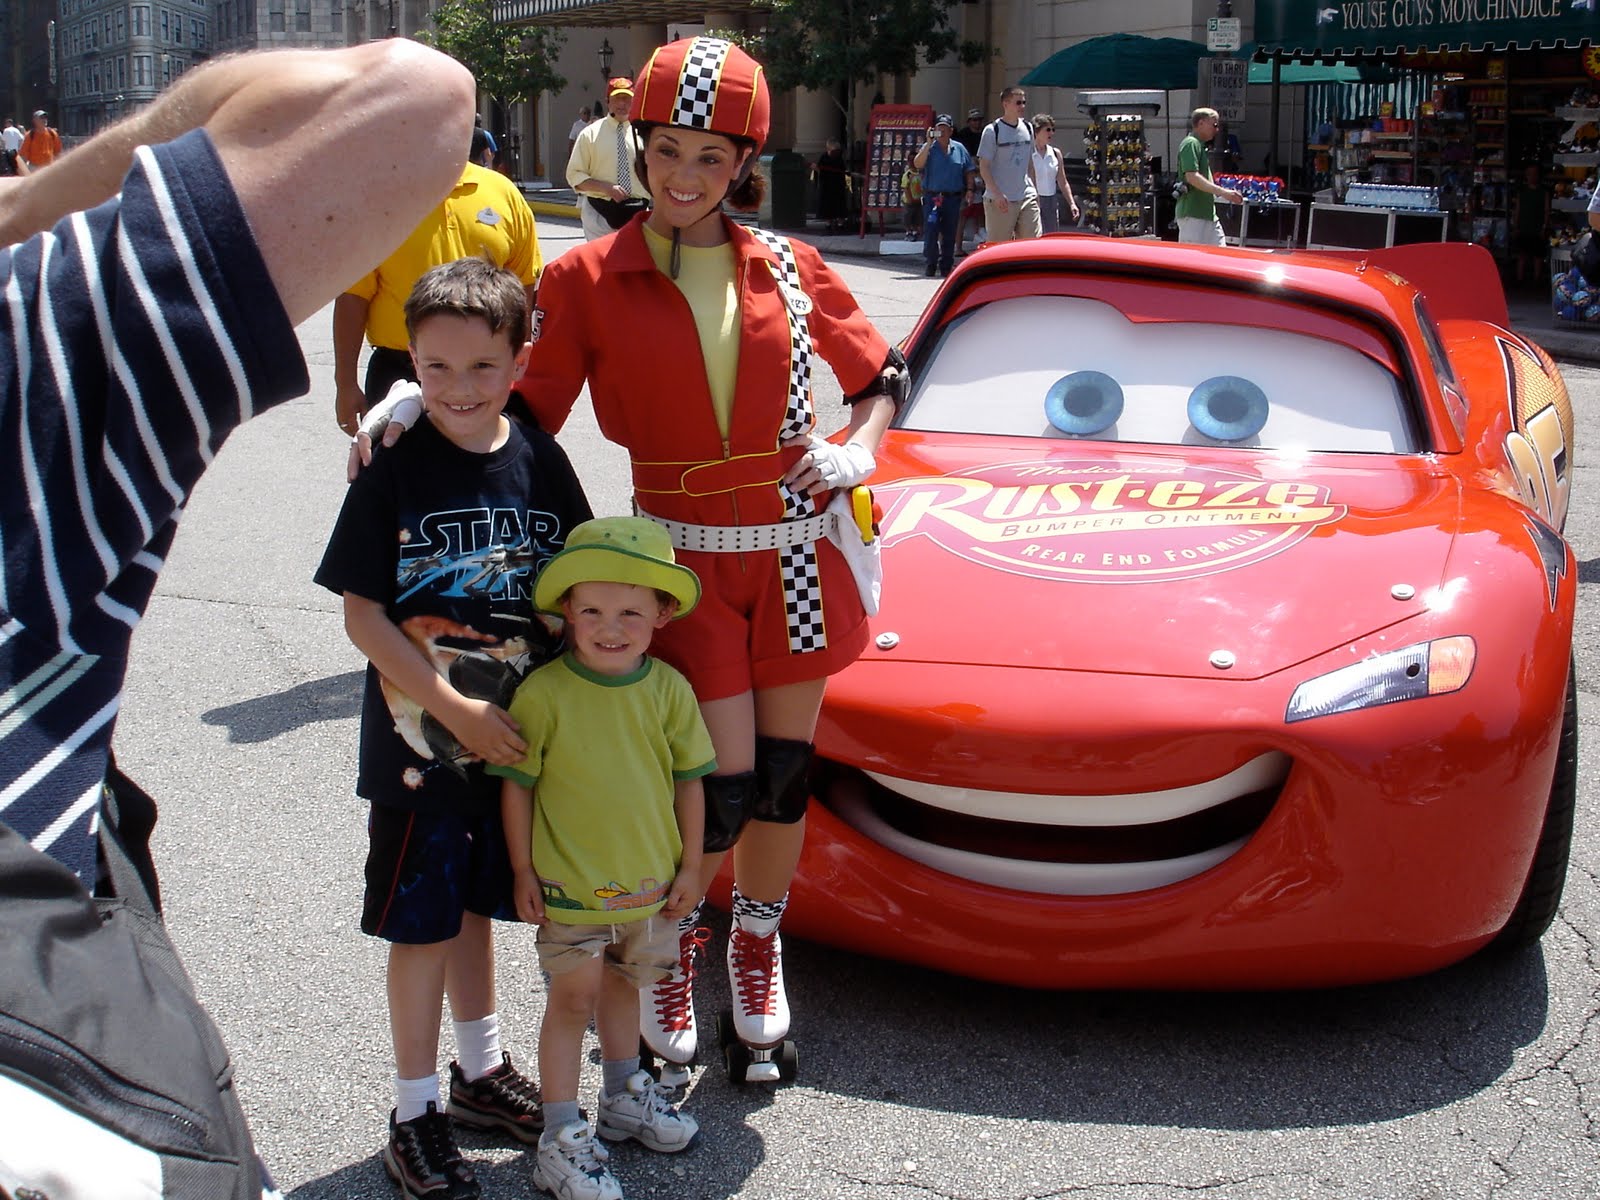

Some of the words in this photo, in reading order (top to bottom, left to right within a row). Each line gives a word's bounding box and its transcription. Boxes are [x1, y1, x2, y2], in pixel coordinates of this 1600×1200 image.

[1341, 0, 1387, 30] YOUSE
[1392, 0, 1434, 28] GUYS
[1439, 0, 1562, 24] MOYCHINDICE
[1213, 76, 1243, 89] TRUCKS
[400, 507, 565, 560] STAR
[1000, 517, 1124, 537] BUMPER
[1144, 511, 1297, 526] OINTMENT
[1020, 543, 1086, 565] REAR
[1101, 552, 1153, 567] END
[1166, 528, 1269, 562] FORMULA
